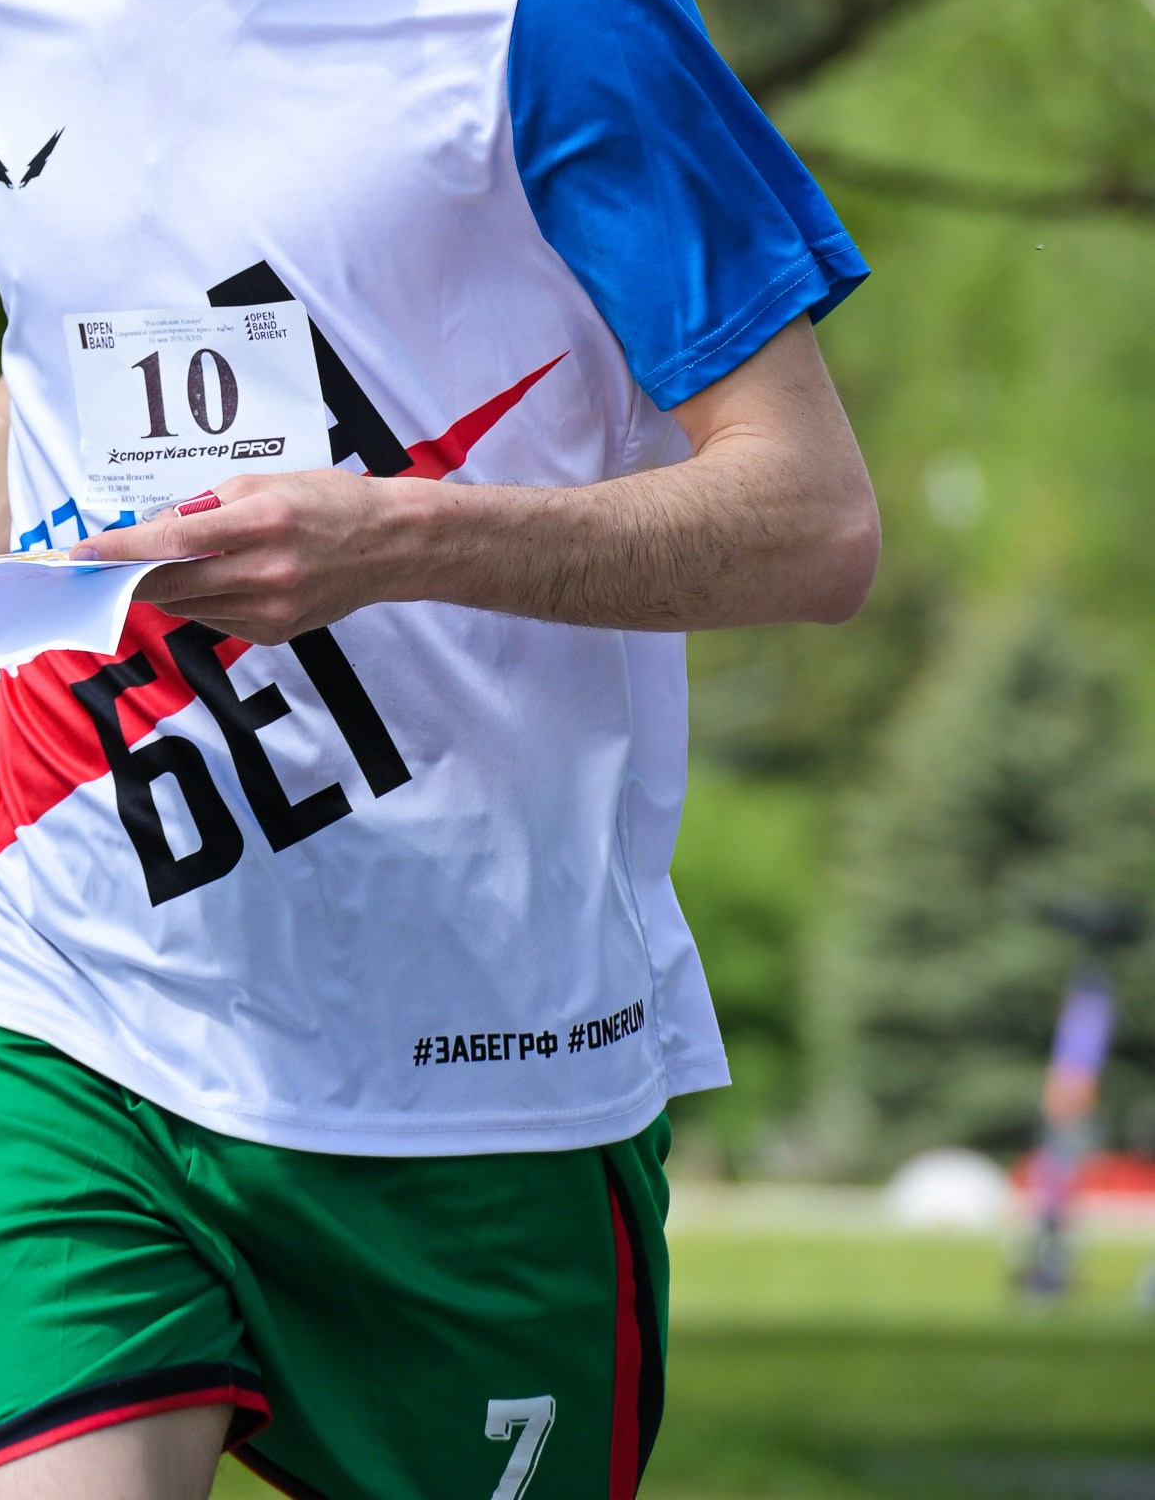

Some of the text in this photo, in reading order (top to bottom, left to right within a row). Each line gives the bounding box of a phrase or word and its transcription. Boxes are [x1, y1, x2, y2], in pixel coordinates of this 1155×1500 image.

[250, 311, 276, 322] OPEN
[86, 322, 113, 335] OPEN
[252, 321, 277, 331] BAND
[253, 329, 288, 341] ORIENT
[88, 336, 115, 350] BAND
[131, 348, 239, 439] 10
[233, 441, 283, 459] PRO
[413, 999, 645, 1066] #ЗАБЕГРФ #ONERUN
[484, 1394, 556, 1500] 7
